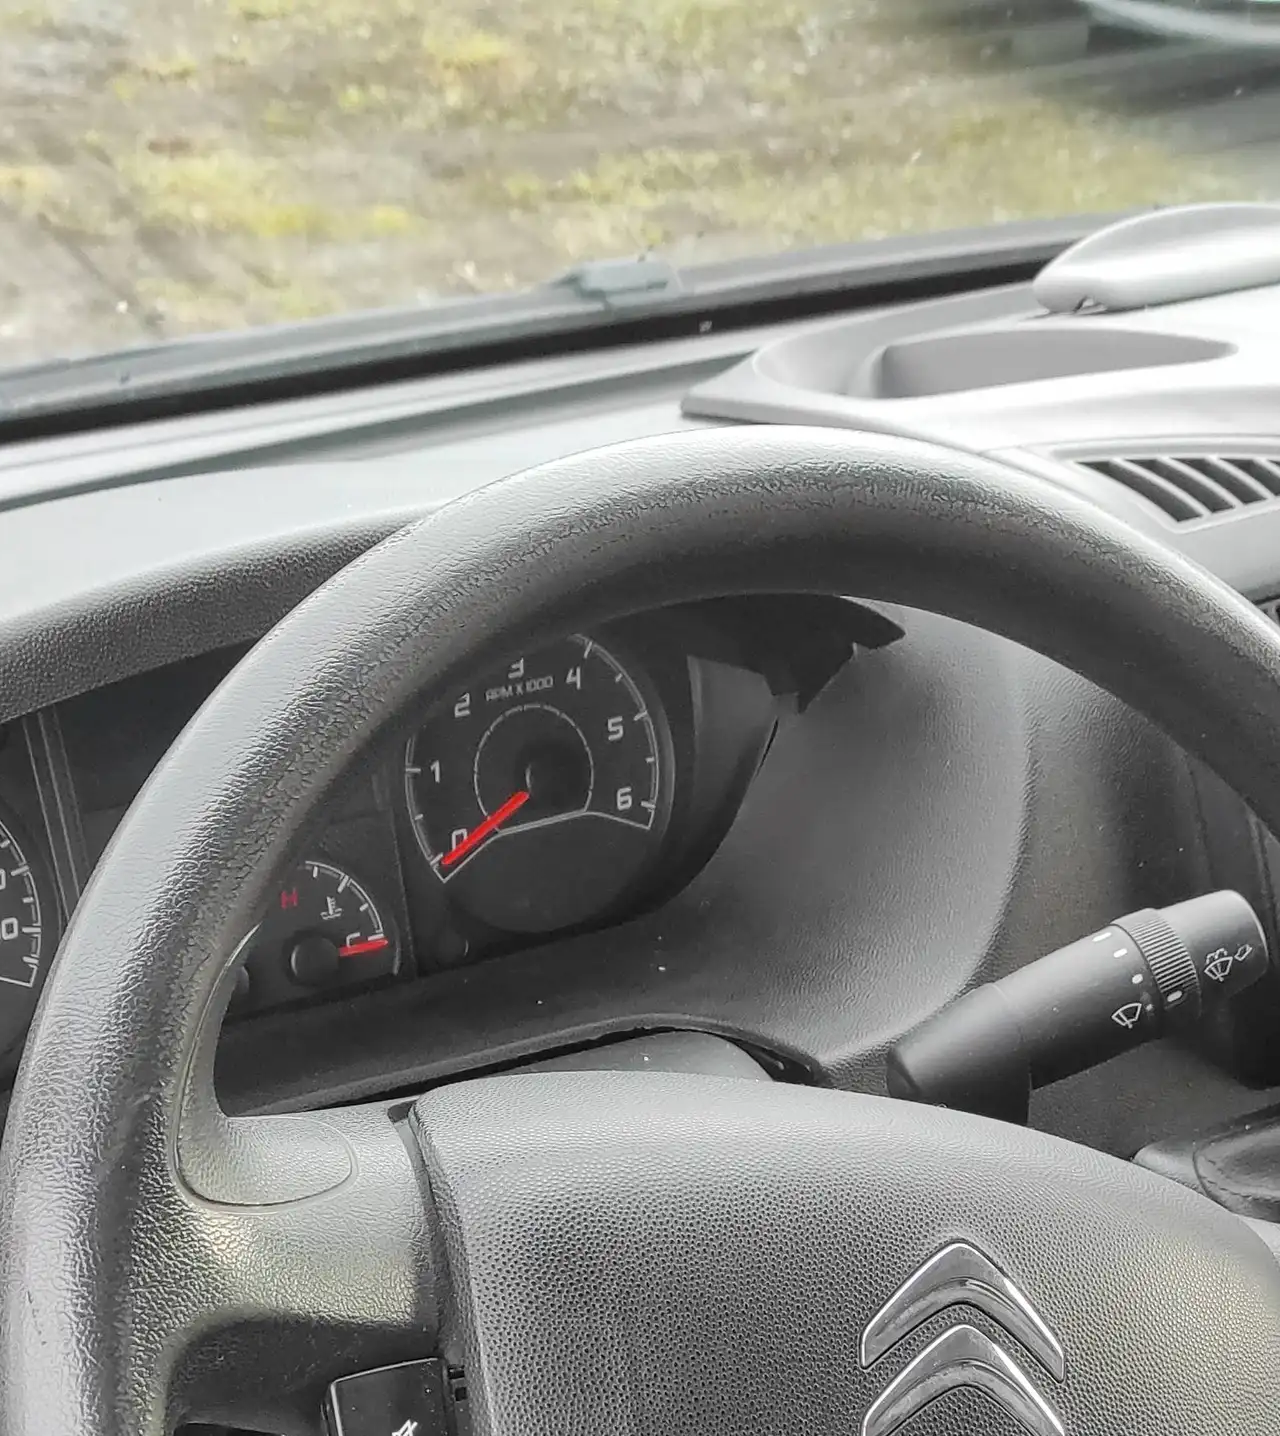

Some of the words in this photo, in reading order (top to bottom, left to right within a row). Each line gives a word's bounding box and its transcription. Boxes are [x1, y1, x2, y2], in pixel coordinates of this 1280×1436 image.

[525, 675, 554, 692] 1000
[566, 665, 582, 690] 4
[608, 717, 624, 741] 5
[430, 760, 441, 783] 1
[616, 785, 633, 811] 6
